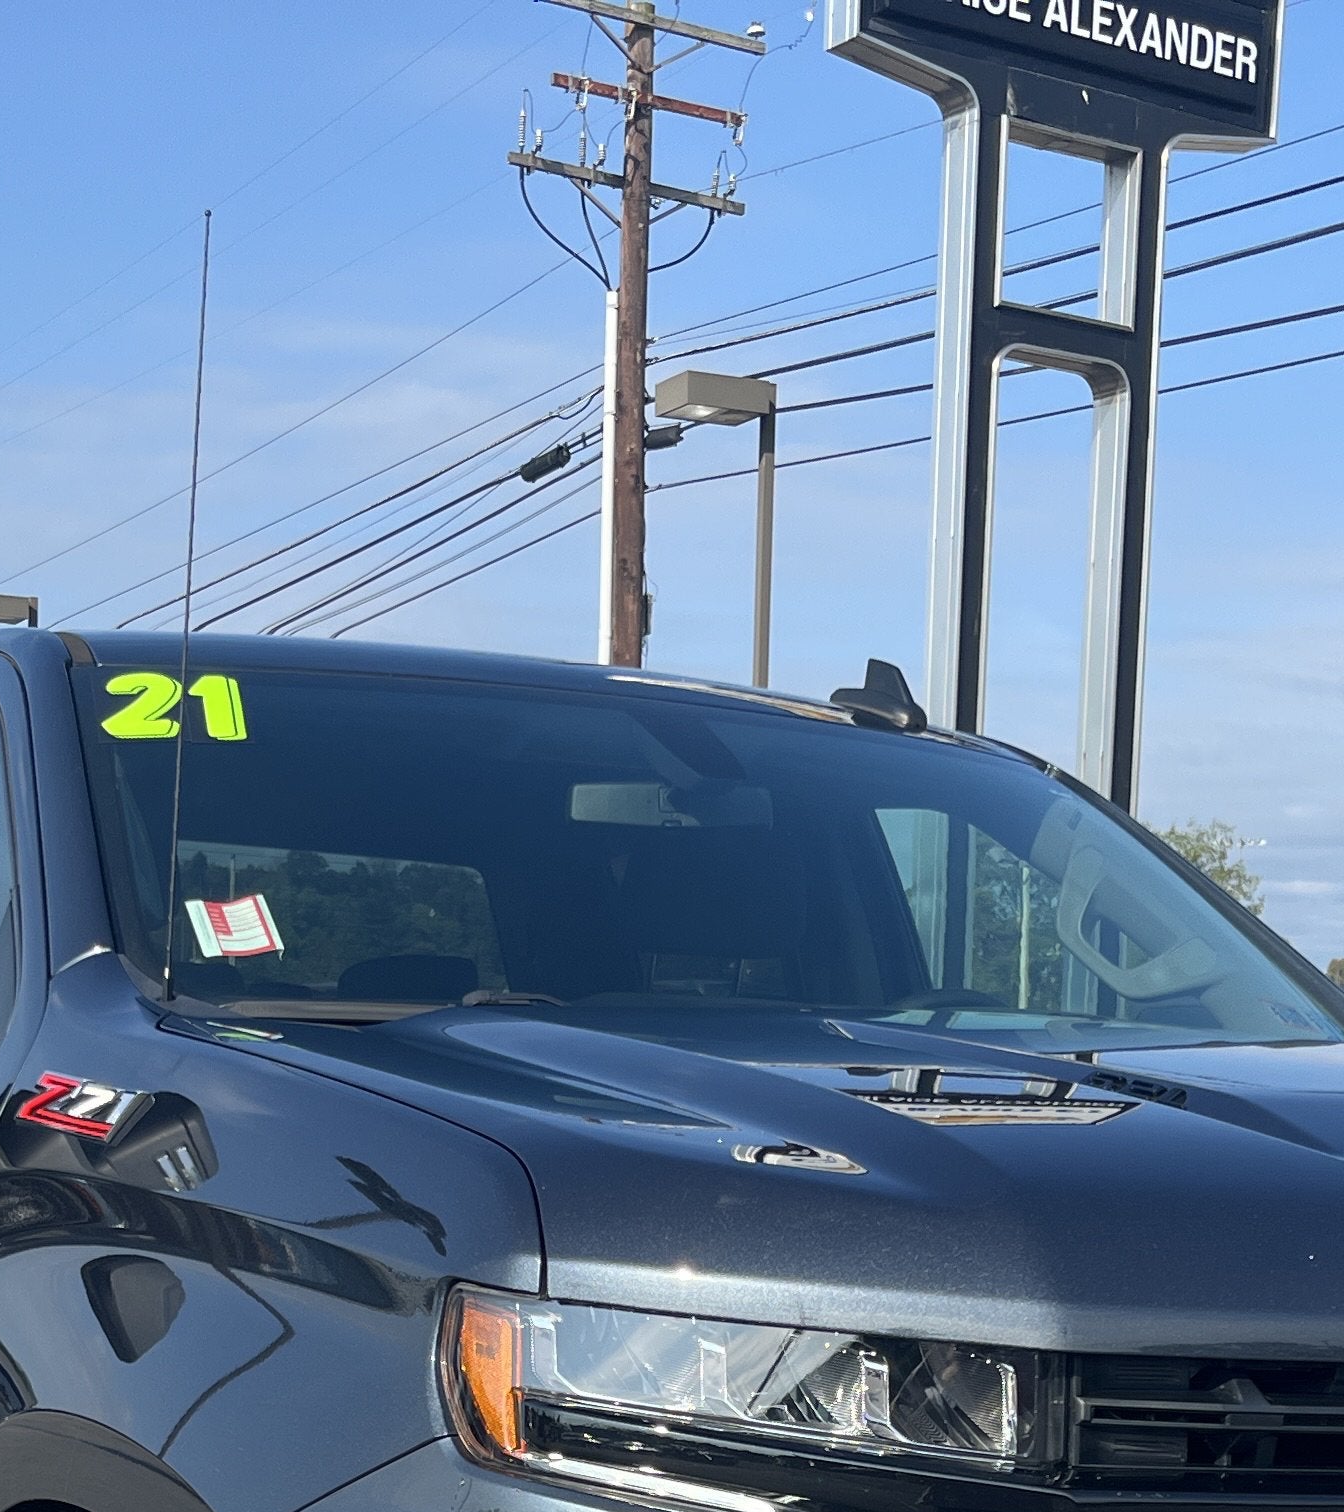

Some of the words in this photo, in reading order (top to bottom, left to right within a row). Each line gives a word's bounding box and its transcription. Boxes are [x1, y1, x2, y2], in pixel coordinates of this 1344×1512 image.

[1043, 0, 1256, 83] ALEXANDER
[101, 673, 248, 740] 21
[16, 1071, 155, 1146] Z71
